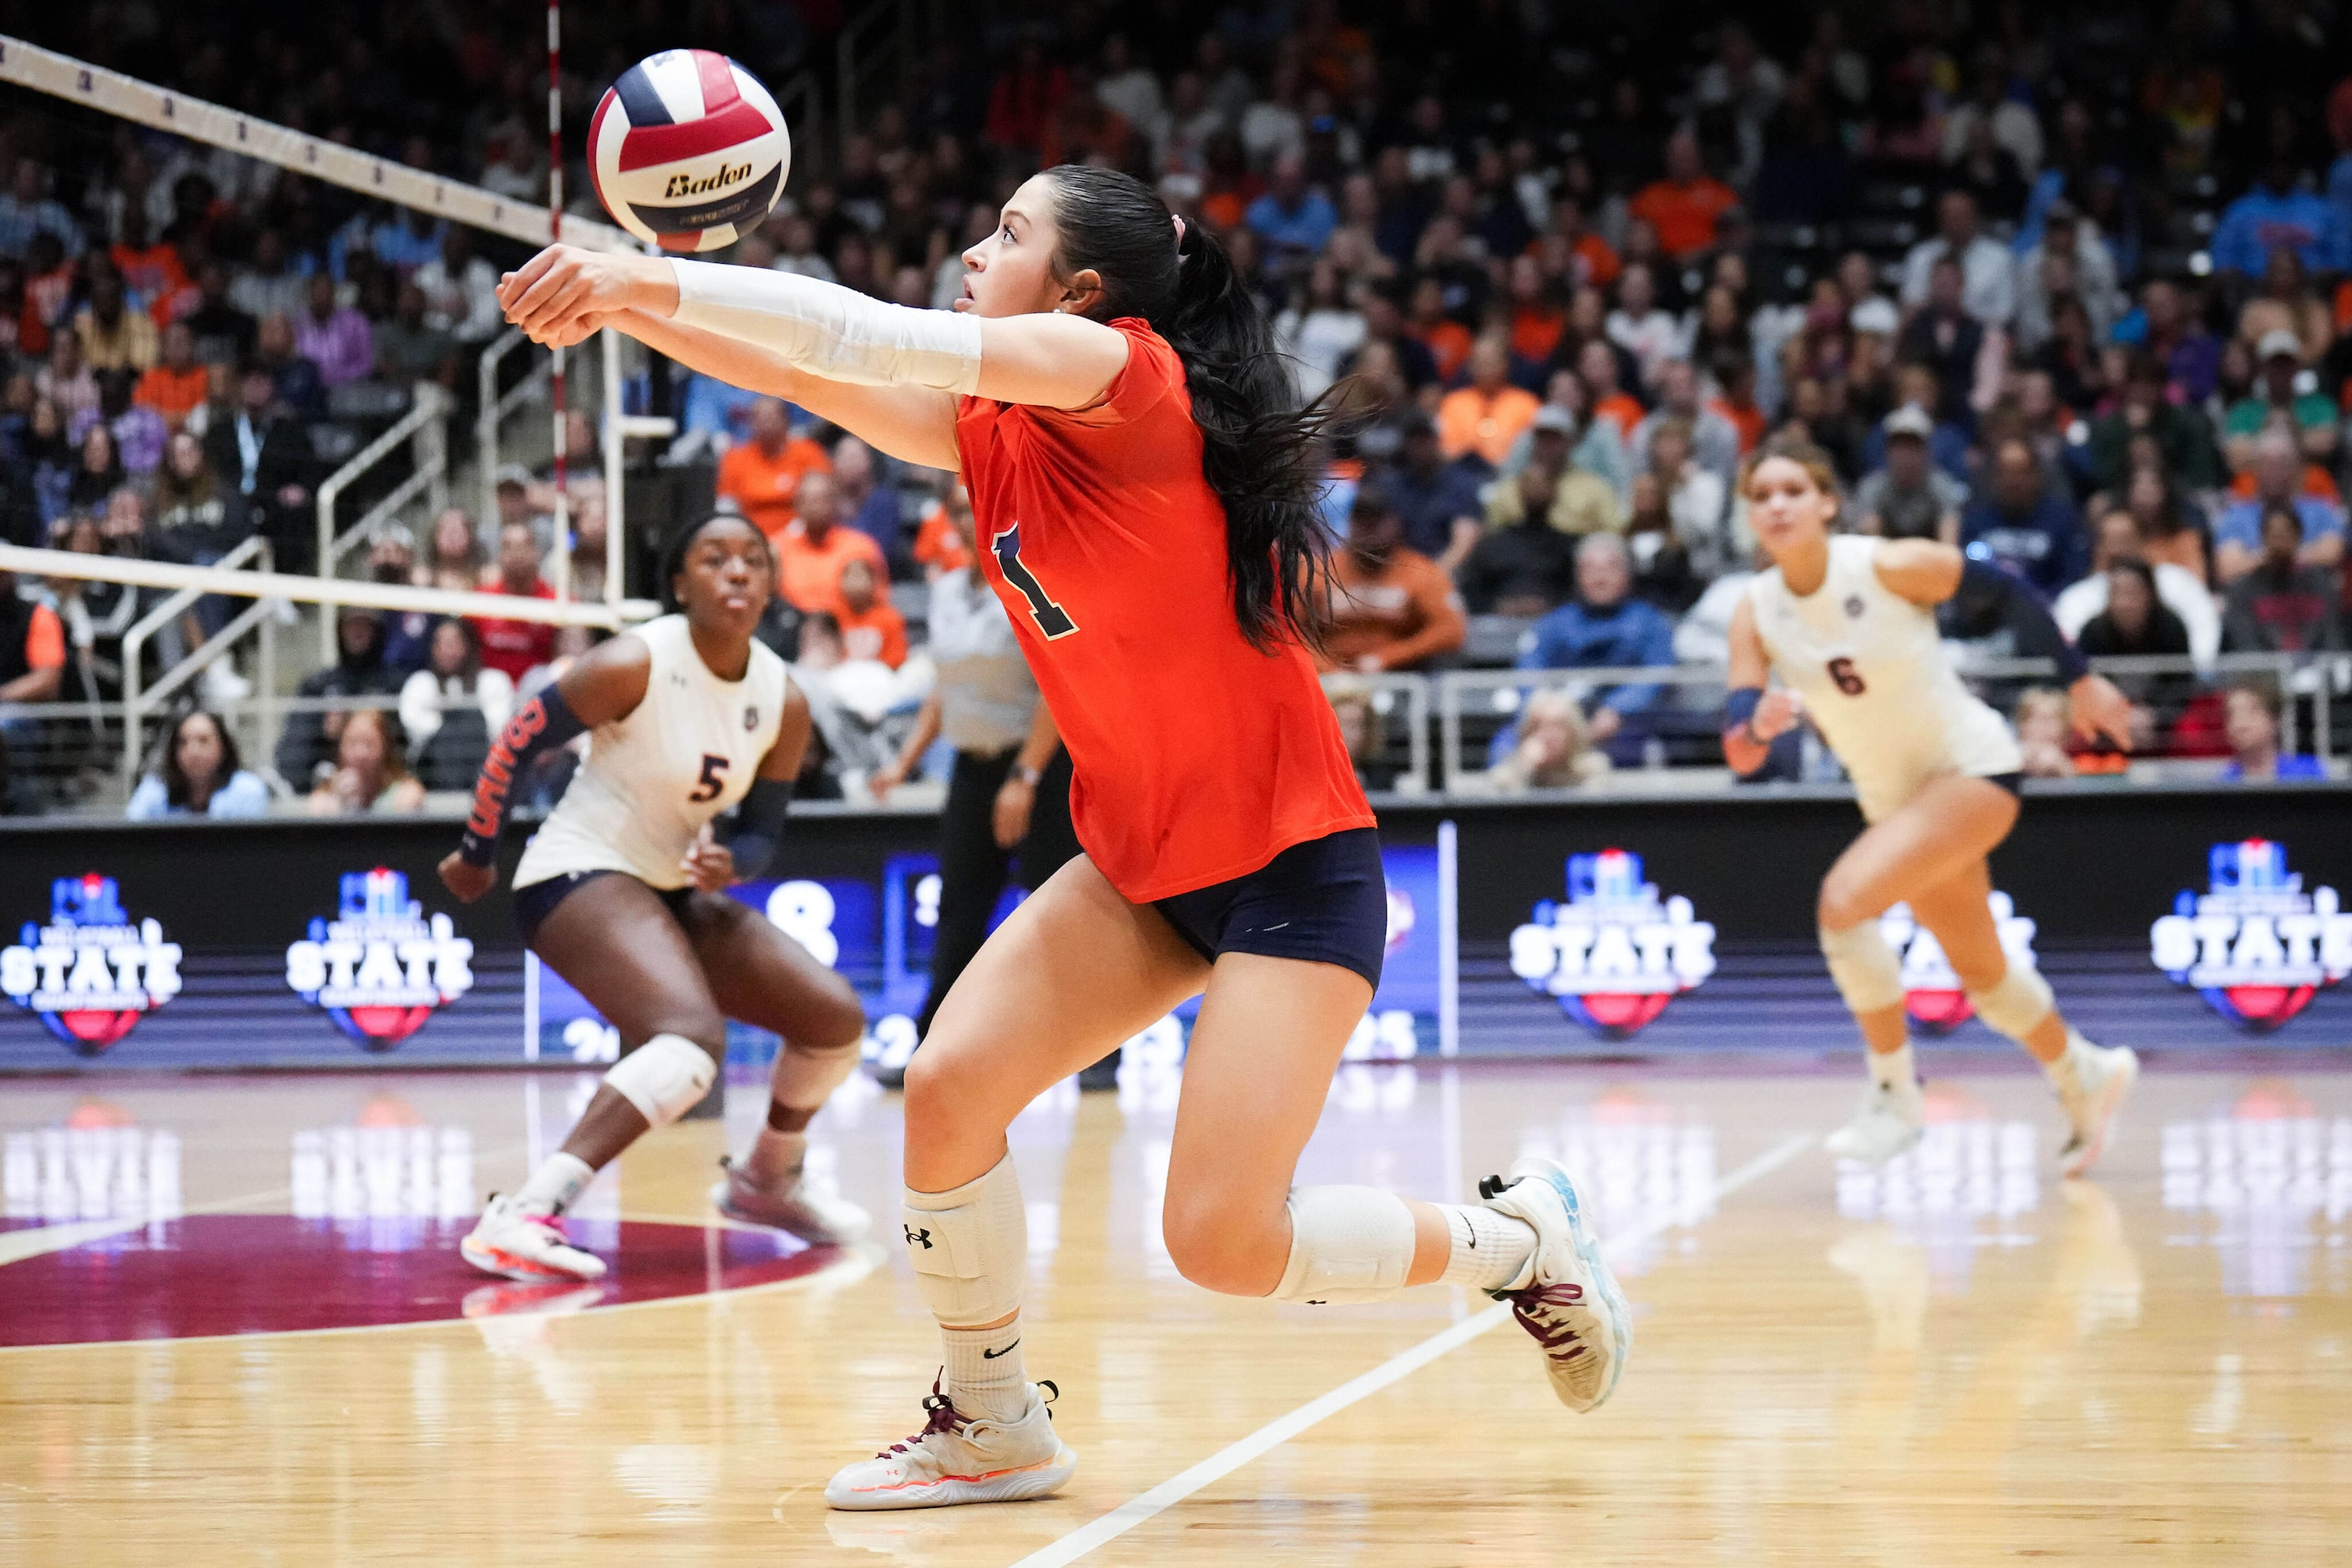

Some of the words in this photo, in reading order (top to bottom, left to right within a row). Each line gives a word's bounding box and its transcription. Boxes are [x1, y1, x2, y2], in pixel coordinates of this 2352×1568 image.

[665, 162, 752, 198] Baden
[990, 520, 1081, 642] 1
[1825, 655, 1867, 697] 6
[688, 752, 730, 803] 5
[0, 943, 183, 997] STATE
[286, 938, 474, 993] STATE
[1510, 921, 1717, 981] STATE
